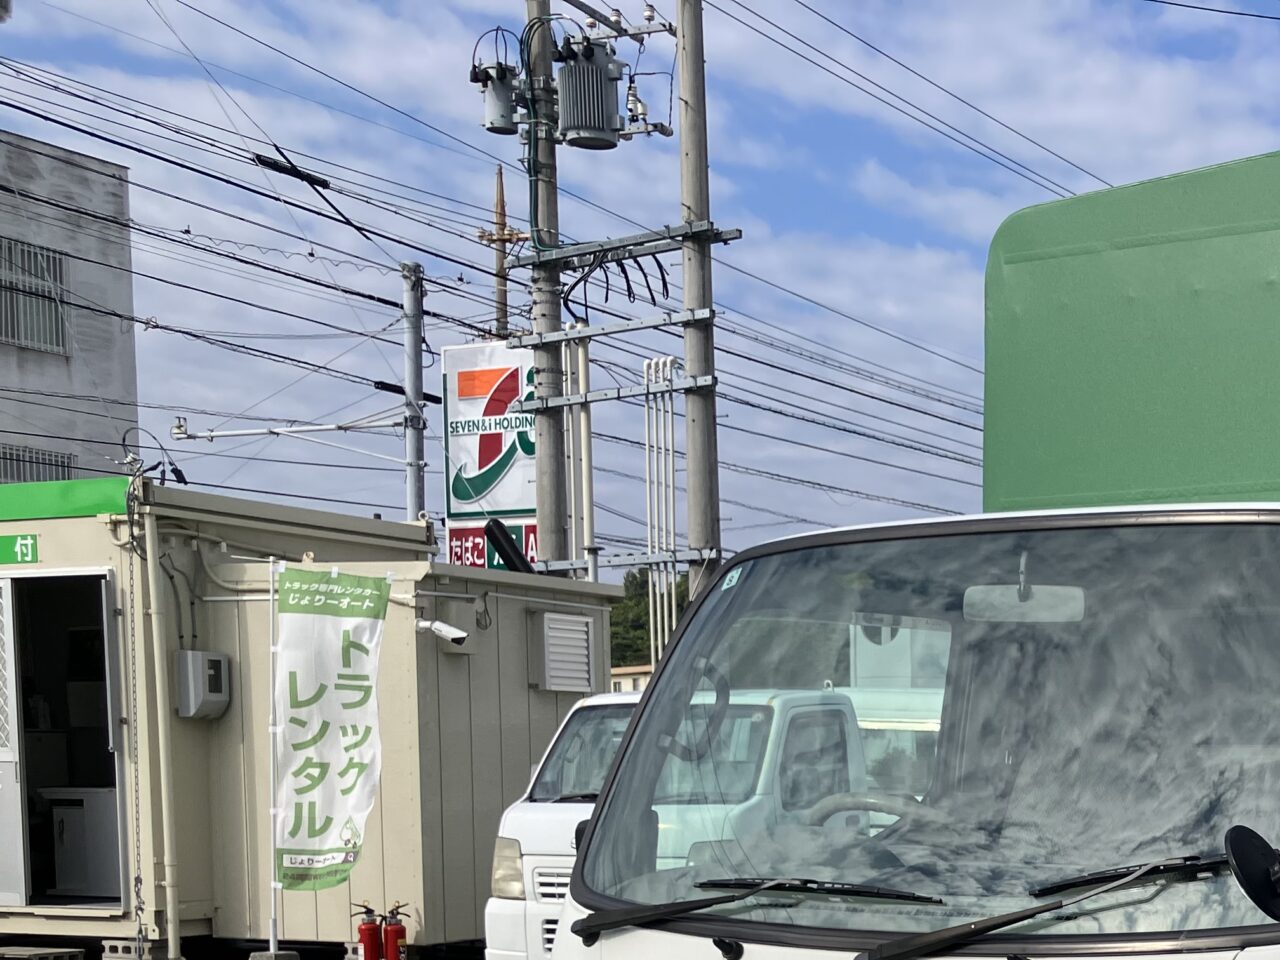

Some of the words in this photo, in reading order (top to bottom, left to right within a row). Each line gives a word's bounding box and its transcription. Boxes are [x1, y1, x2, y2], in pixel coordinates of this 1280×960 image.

[14, 535, 34, 562] 付
[451, 536, 485, 566] たばこ
[287, 671, 334, 839] レンタル
[334, 629, 373, 797] トラック
